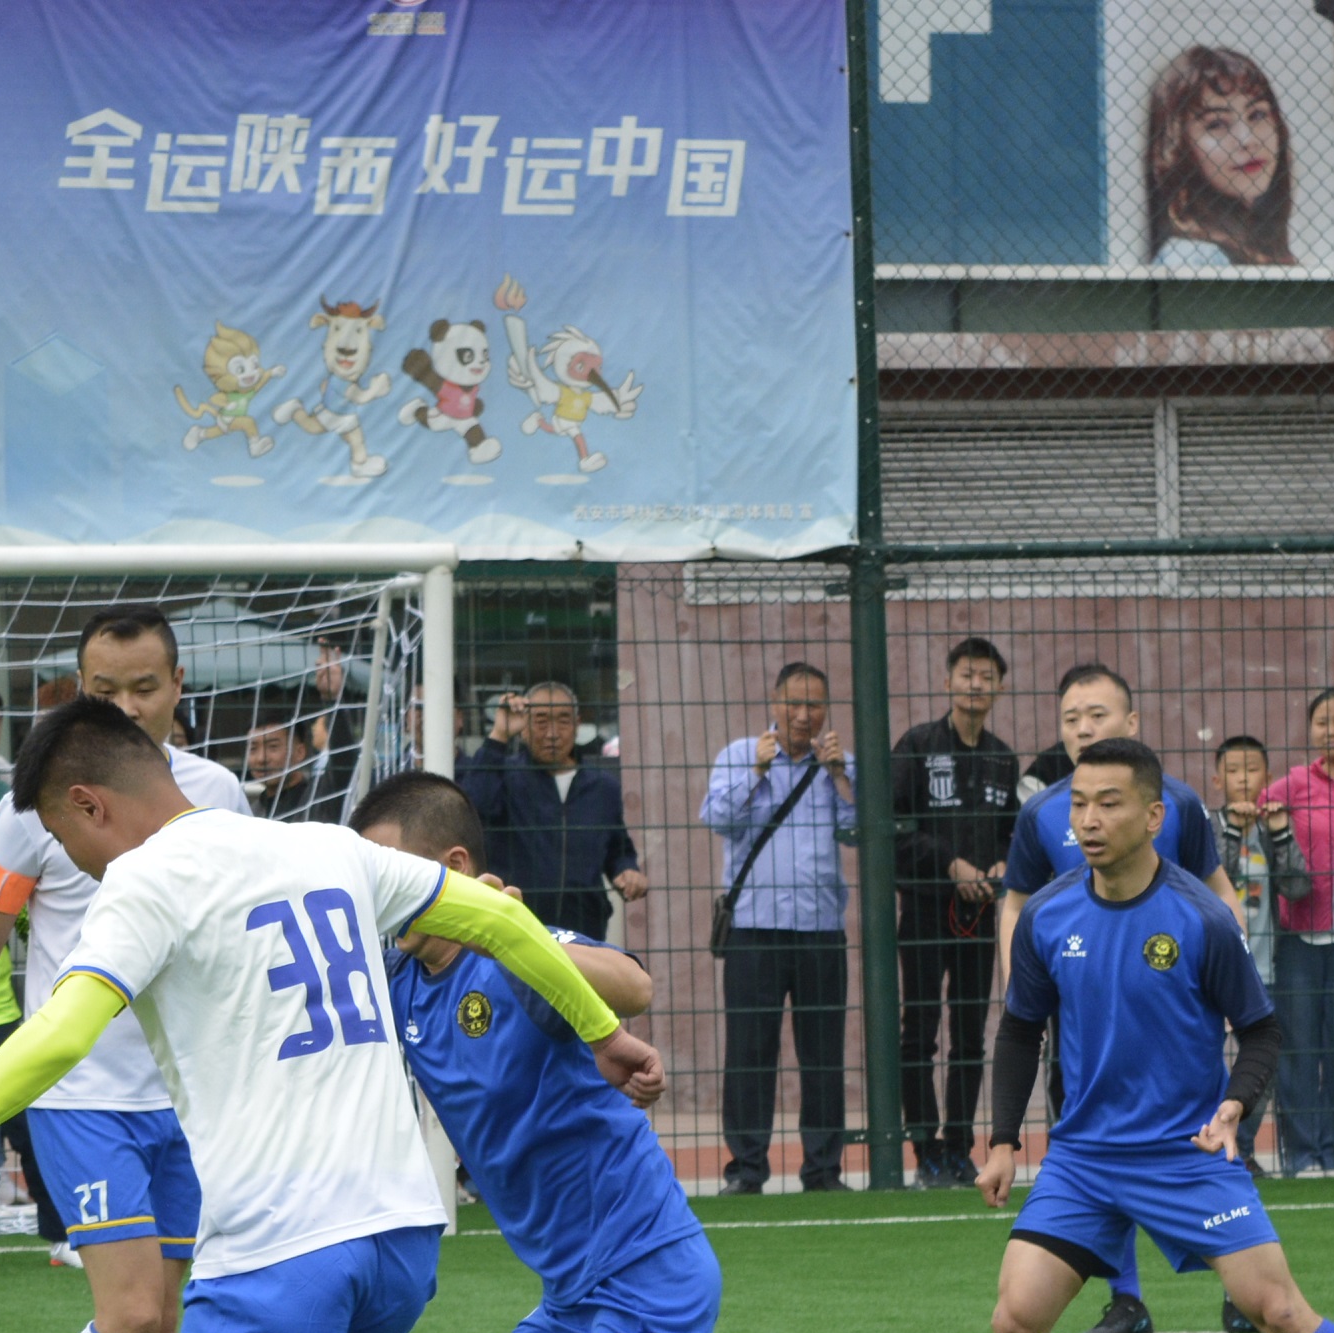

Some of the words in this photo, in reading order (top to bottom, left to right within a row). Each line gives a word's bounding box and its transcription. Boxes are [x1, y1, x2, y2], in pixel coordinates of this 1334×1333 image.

[57, 106, 397, 216] 全运陕西
[414, 113, 747, 218] 好运中国
[245, 887, 389, 1062] 38
[73, 1179, 109, 1225] 27
[1203, 1205, 1251, 1231] KELME
